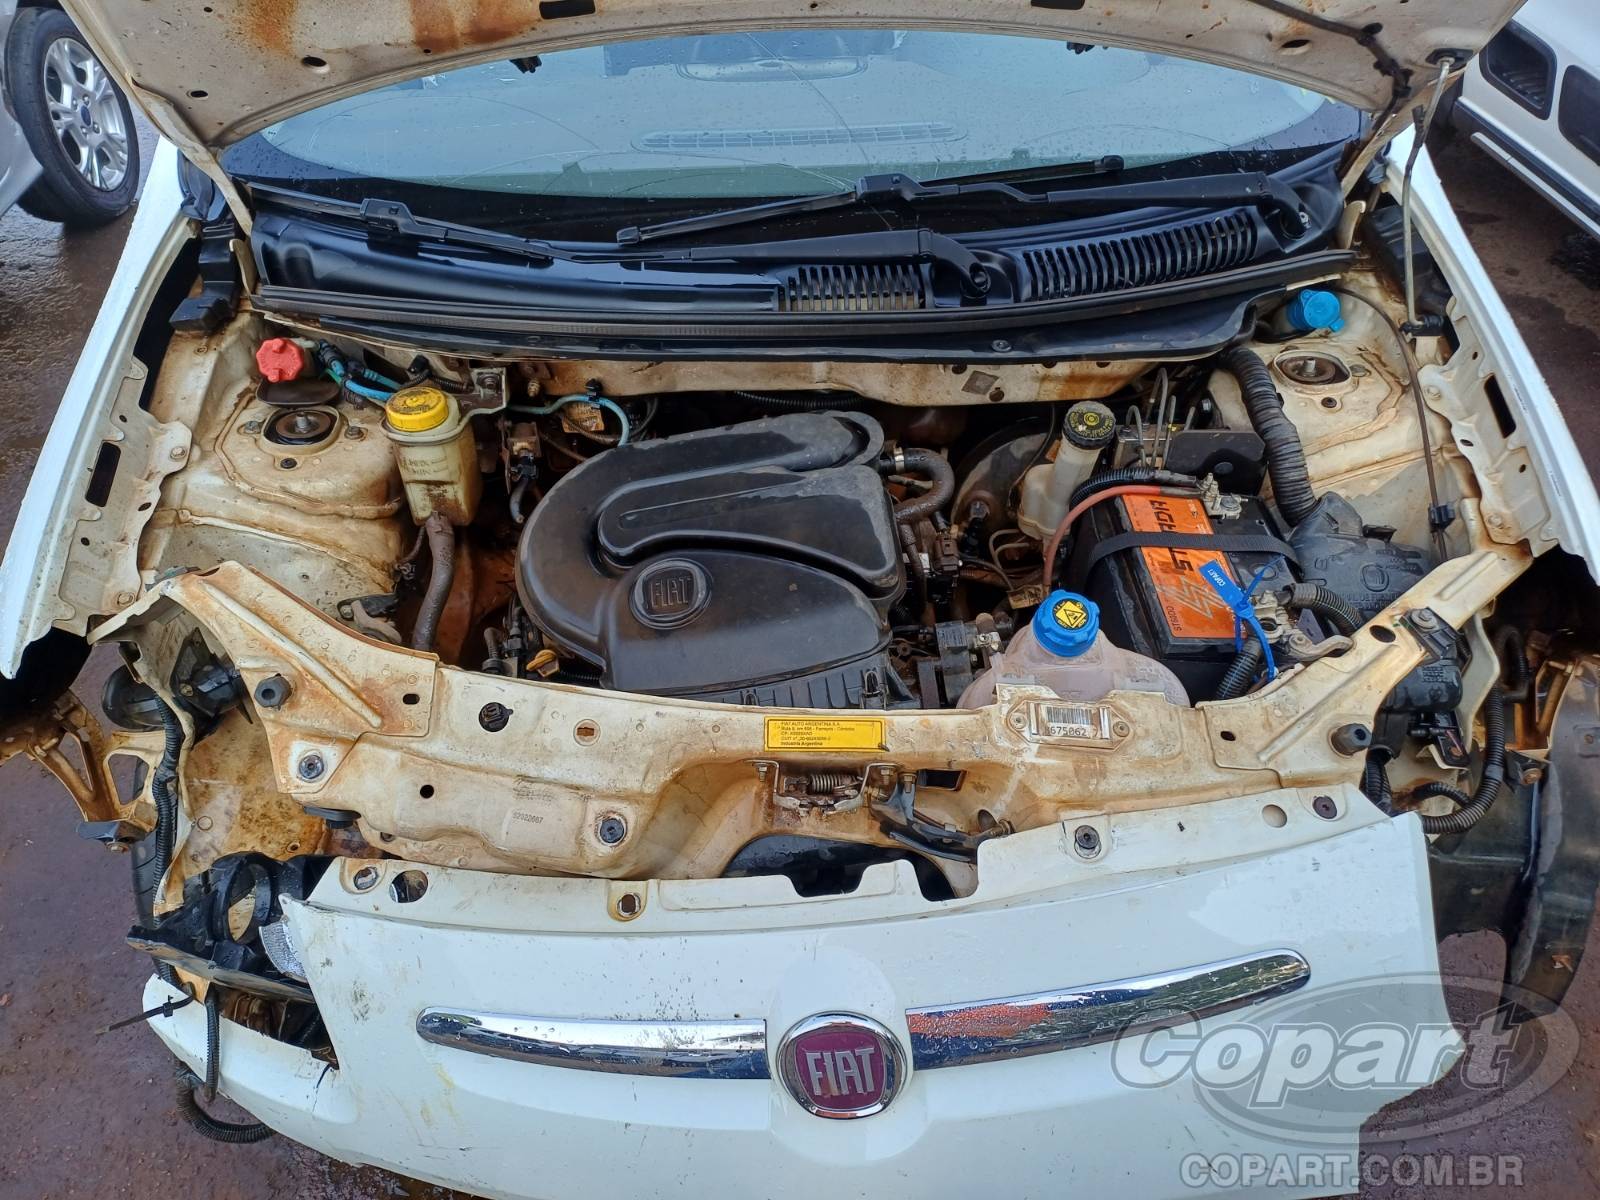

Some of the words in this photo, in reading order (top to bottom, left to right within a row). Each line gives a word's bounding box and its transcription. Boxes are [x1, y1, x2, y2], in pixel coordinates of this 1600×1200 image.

[1149, 499, 1194, 576] STADA
[650, 576, 692, 608] FIAT
[1207, 568, 1226, 587] COPART
[806, 1047, 875, 1096] FIAT
